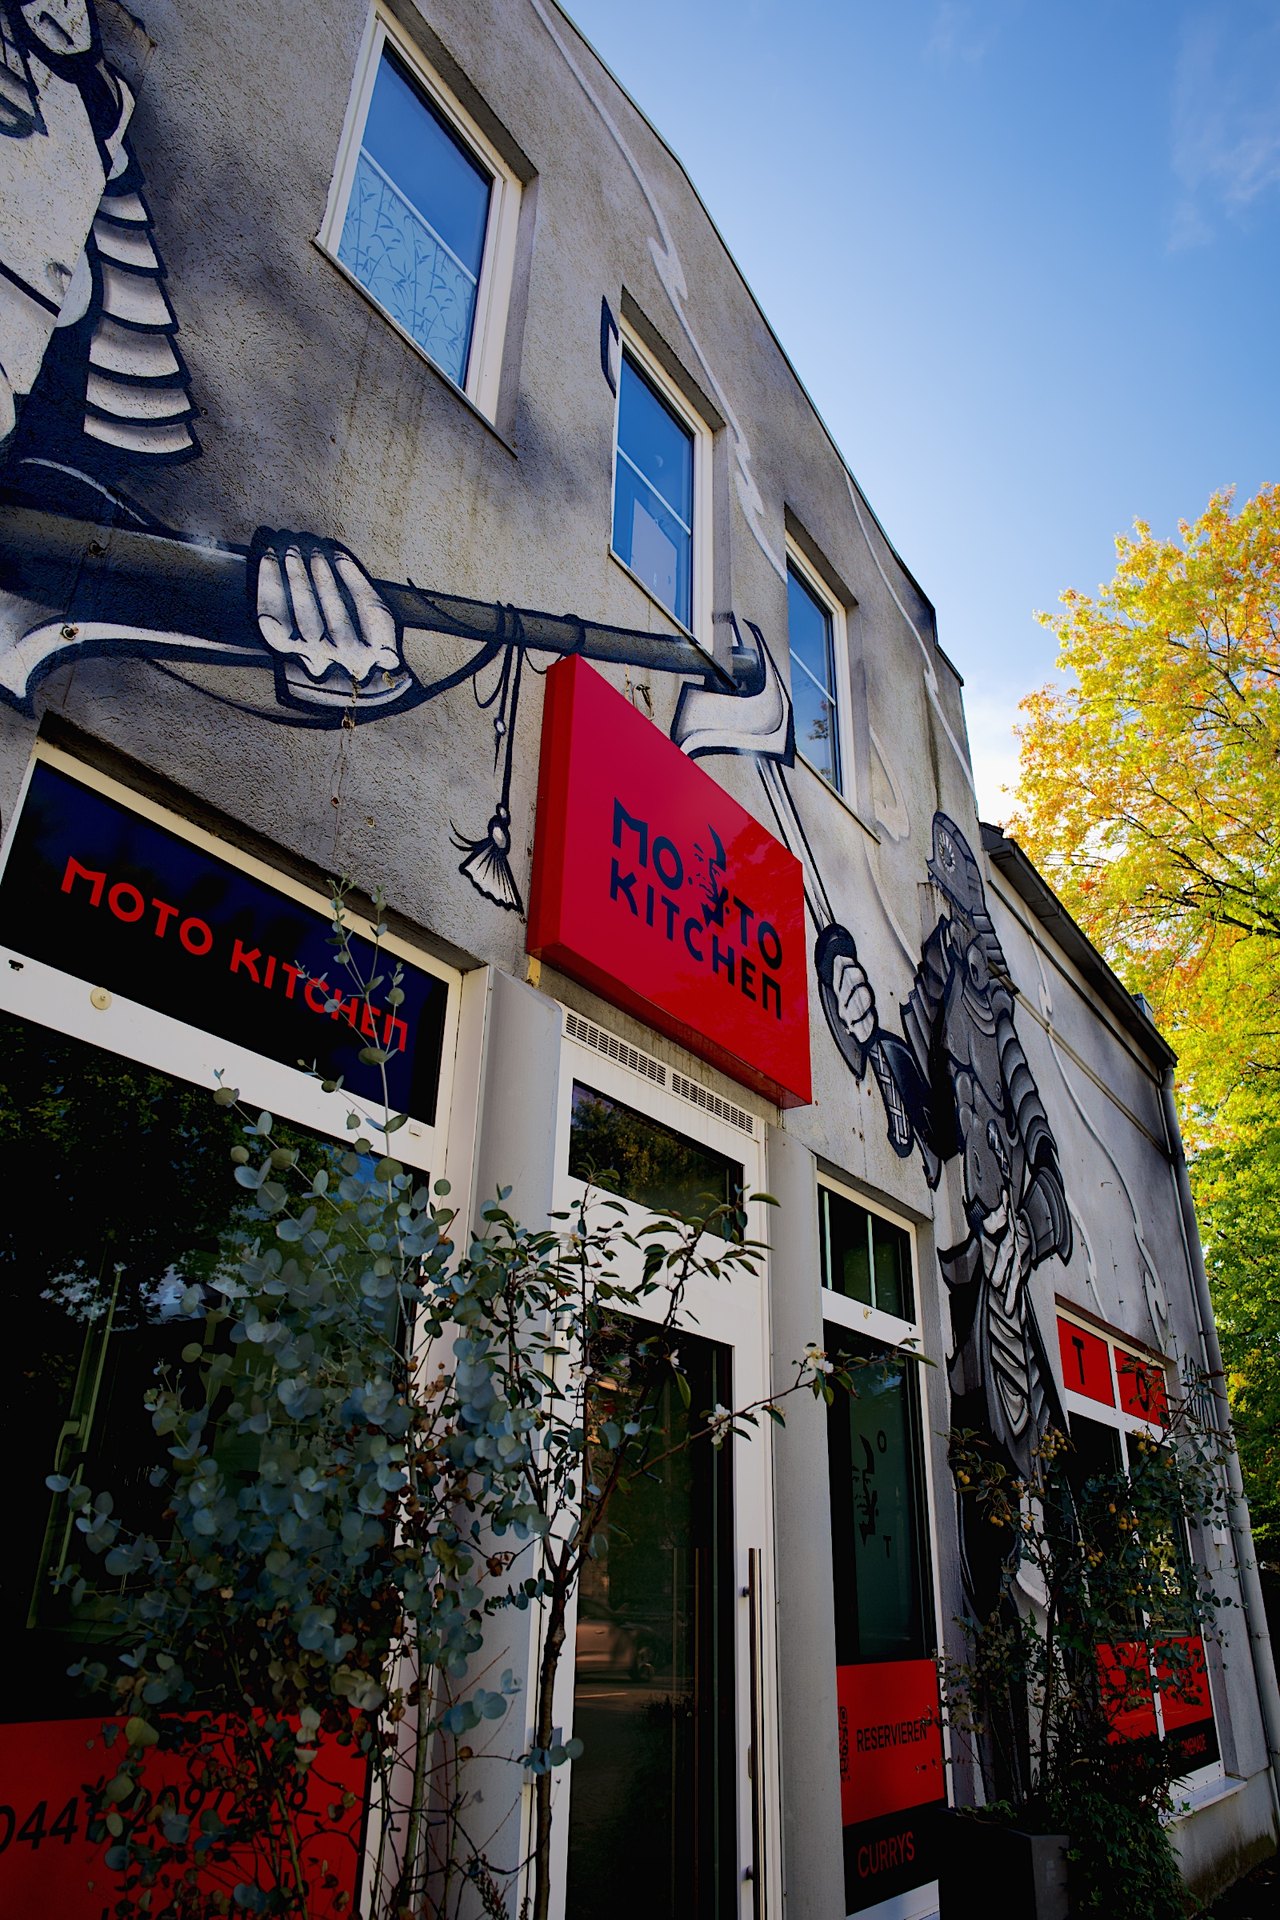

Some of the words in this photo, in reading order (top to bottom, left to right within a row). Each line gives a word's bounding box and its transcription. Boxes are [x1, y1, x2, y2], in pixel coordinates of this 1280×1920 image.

[60, 855, 214, 956] MOTO
[229, 938, 409, 1053] KITCHEN
[609, 856, 782, 1021] KITCHEN
[856, 1720, 928, 1753] RESERVIEREN
[857, 1831, 916, 1879] CURRYS
